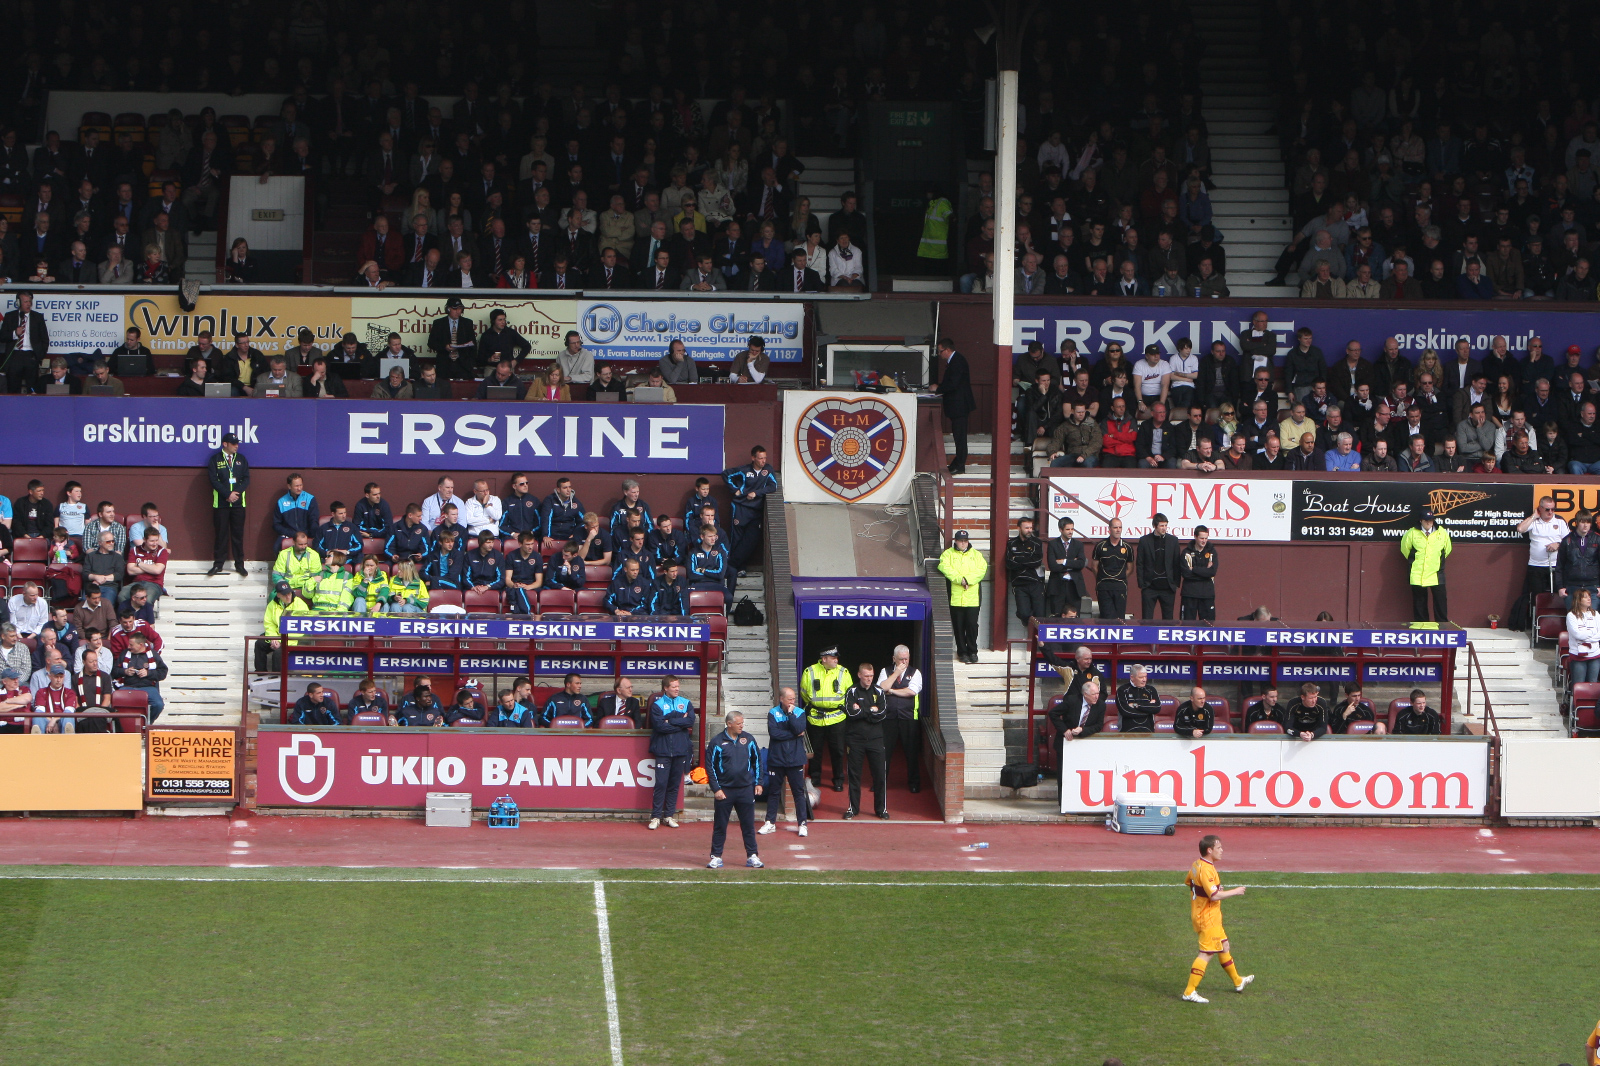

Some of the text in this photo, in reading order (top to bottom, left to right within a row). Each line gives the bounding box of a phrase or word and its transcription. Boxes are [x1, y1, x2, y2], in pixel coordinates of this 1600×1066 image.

[36, 300, 100, 310] EVERY SKIP
[52, 313, 81, 322] EVER
[86, 313, 118, 322] NEED
[588, 310, 798, 339] 1st Choice Glazing
[50, 340, 119, 349] coastskips.co.uk
[150, 338, 198, 350] timbe
[284, 340, 294, 350] &
[692, 350, 725, 359] Bathgate
[775, 350, 797, 359] 1187
[347, 411, 689, 460] ERSKINE
[837, 470, 865, 480] 1874
[1146, 482, 1250, 521] FMS
[1302, 494, 1411, 514] Boat House
[1485, 510, 1501, 518] High
[1445, 518, 1488, 526] Queensferry
[1091, 526, 1110, 535] FIR
[1125, 526, 1151, 536] AND
[1226, 528, 1251, 537] LTD
[1302, 526, 1324, 536] 0131
[1328, 527, 1346, 536] 331
[1350, 527, 1374, 536] 5429
[818, 605, 908, 617] ERSKINE
[286, 620, 375, 633] ERSKINE
[400, 621, 488, 635] ERSKINE
[508, 624, 596, 636] ERSKINE
[614, 625, 701, 638] ERSKINE
[1046, 628, 1134, 640] ERSKINE
[1158, 629, 1246, 642] ERSKINE
[1266, 631, 1354, 644] ERSKINE
[1371, 632, 1458, 645] ERSKINE
[295, 656, 363, 666] ERSKINE
[379, 658, 448, 668] ERSKINE
[460, 659, 528, 668] ERSKINE
[541, 660, 608, 670] ERSKINE
[626, 661, 694, 670] ERSKINE
[1124, 664, 1190, 674] ESKINE
[1203, 666, 1269, 675] ERSKINE
[1282, 667, 1350, 676] ERSKINE
[1368, 667, 1435, 676] ERSKINE
[152, 737, 233, 746] BUCHANAN
[153, 747, 232, 757] SKIP HIRE
[360, 748, 656, 787] ŪKIO BANKAS
[1076, 745, 1473, 809] umbro.com
